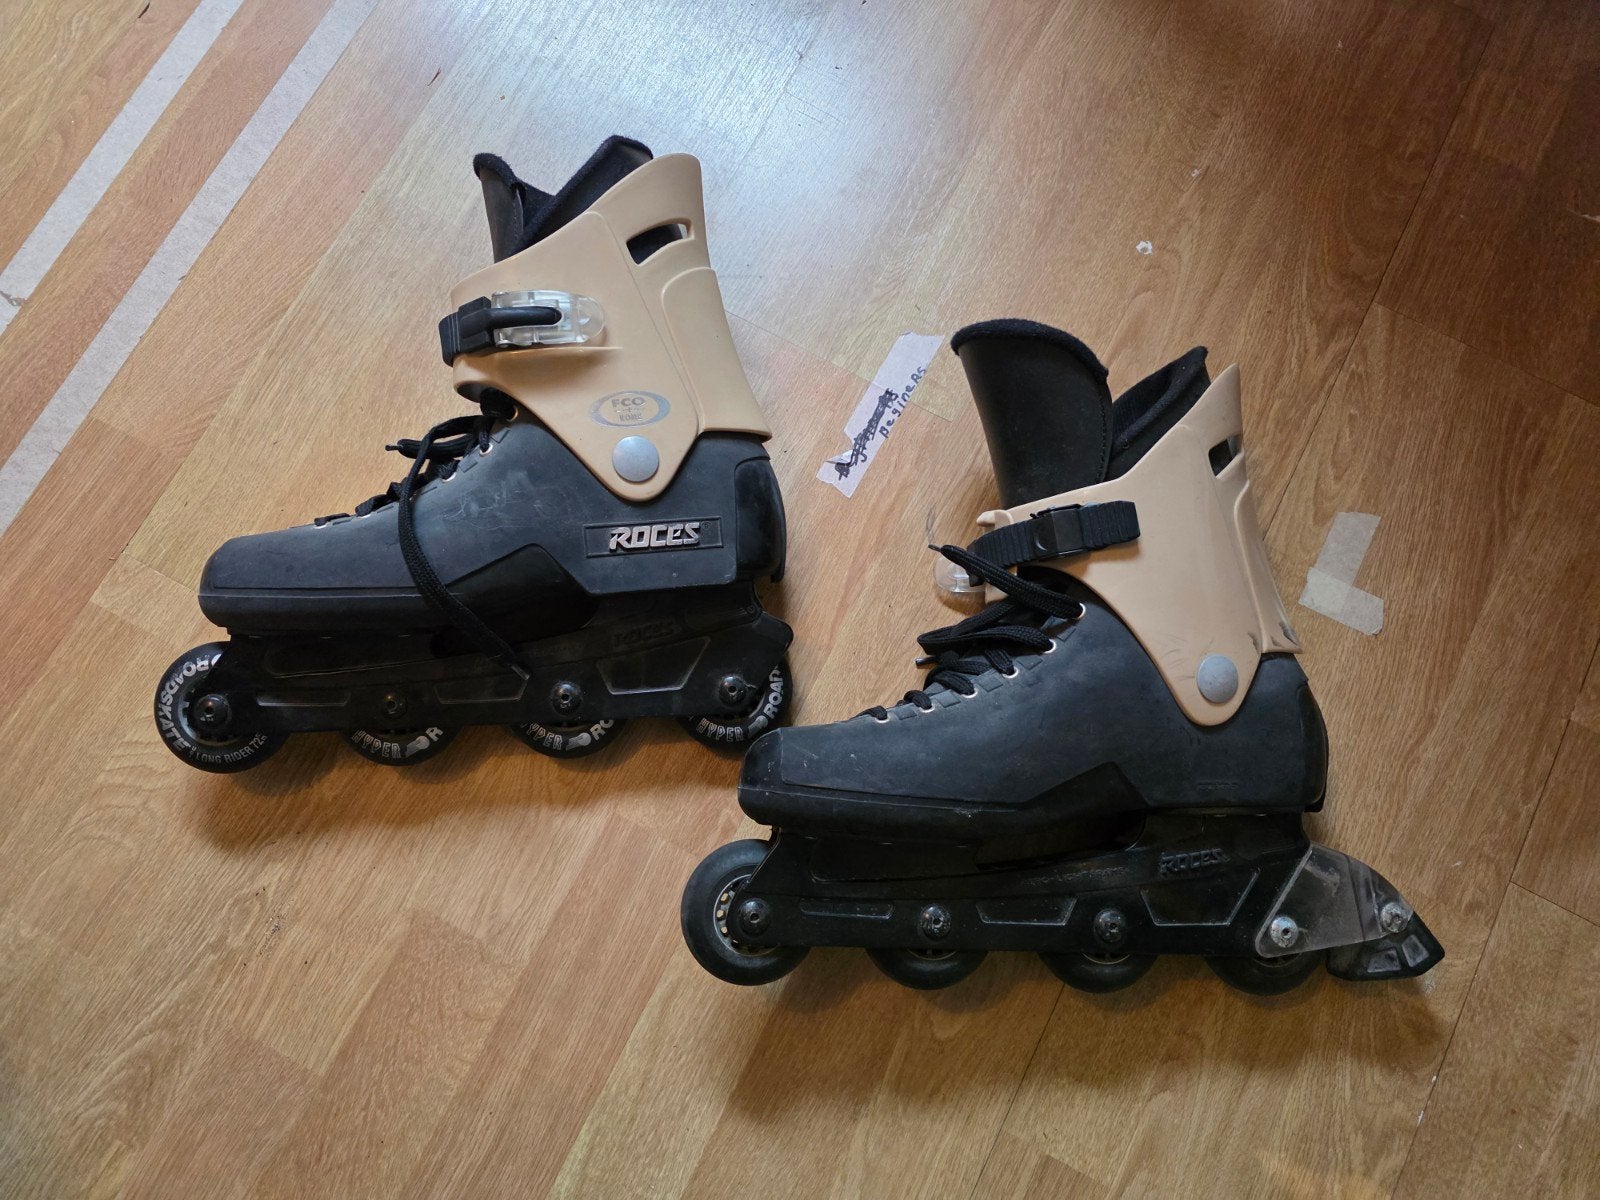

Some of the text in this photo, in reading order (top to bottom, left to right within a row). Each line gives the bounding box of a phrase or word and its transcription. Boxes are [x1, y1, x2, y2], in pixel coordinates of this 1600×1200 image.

[608, 522, 700, 550] ROCES
[351, 729, 401, 759] HYPER
[521, 721, 563, 751] YPER
[696, 718, 744, 742] HYPER
[224, 745, 255, 764] RIDER
